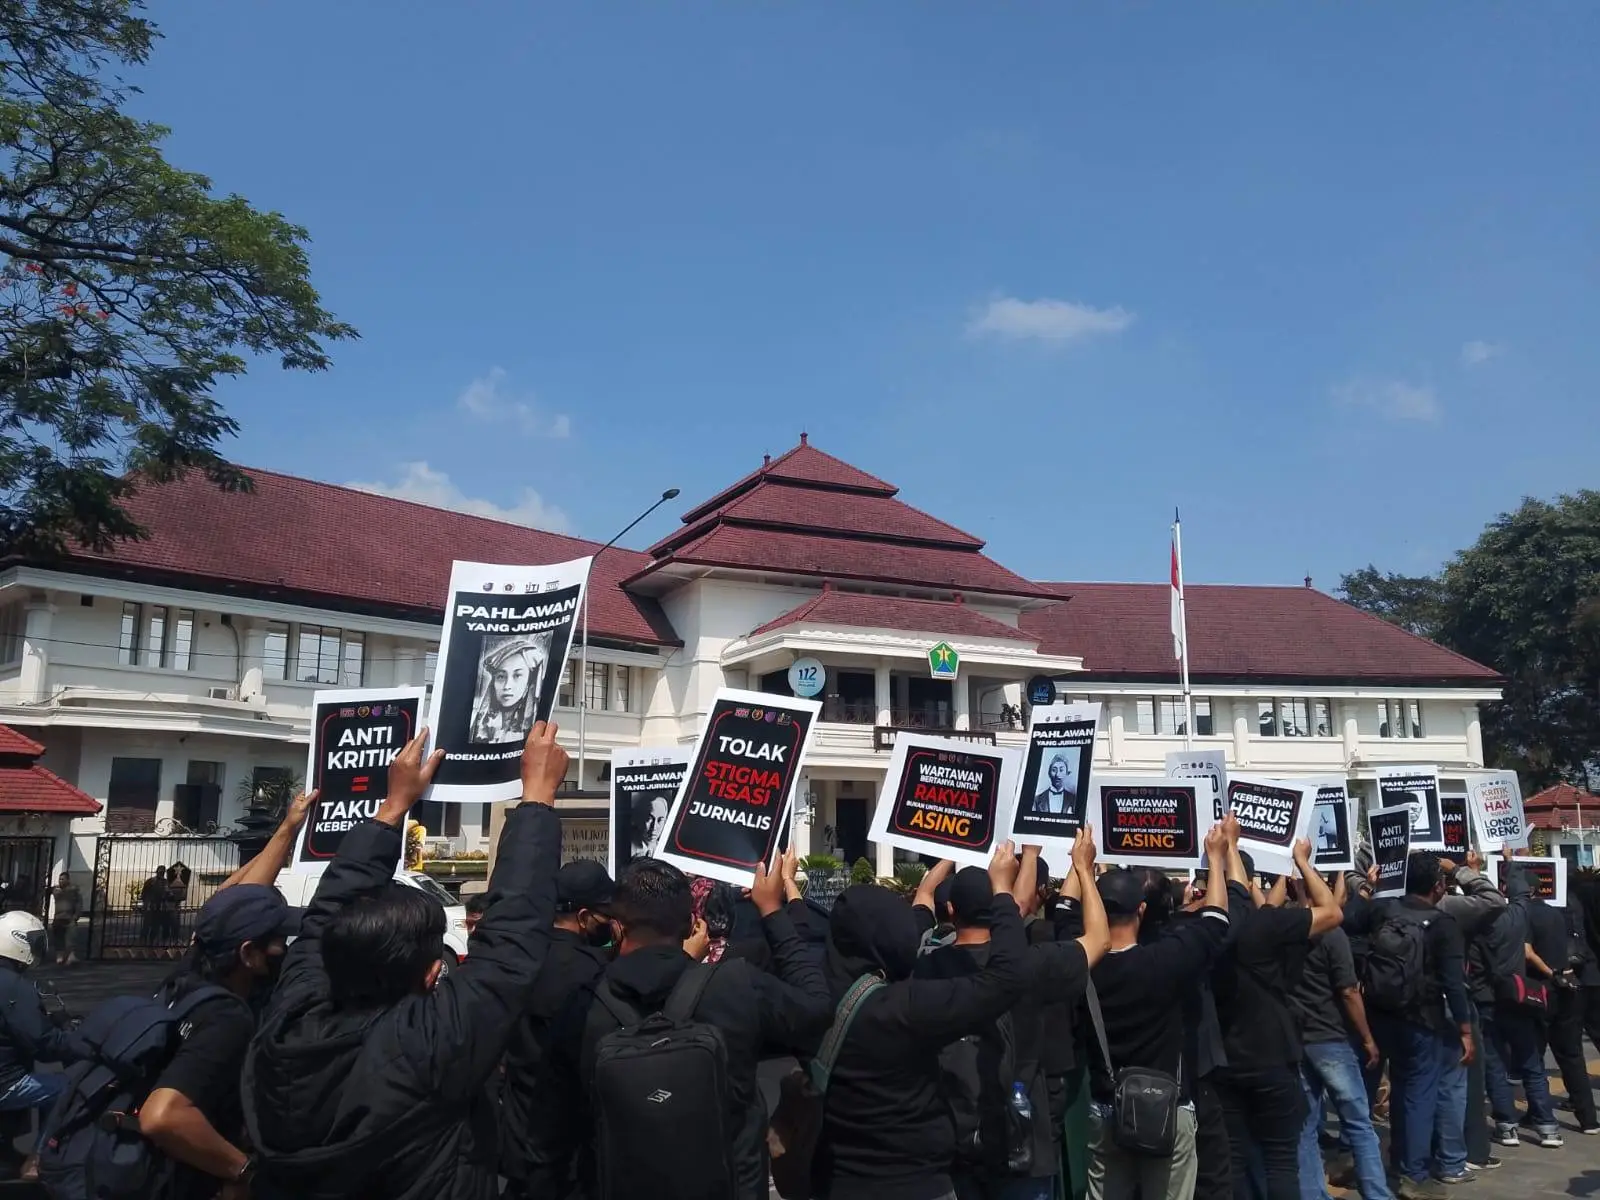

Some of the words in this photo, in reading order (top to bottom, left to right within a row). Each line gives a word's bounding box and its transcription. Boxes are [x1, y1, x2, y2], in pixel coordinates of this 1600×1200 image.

[456, 597, 577, 620] PAHLAWAN
[466, 622, 510, 632] YANG
[511, 614, 571, 633] JURNALIS
[798, 666, 818, 681] 112
[338, 726, 393, 747] ANTI
[1032, 728, 1094, 739] PAHLAWAN
[445, 753, 501, 761] ROEHANA
[501, 749, 525, 759] KOED
[718, 736, 788, 762] TOLAK
[327, 747, 402, 770] KRITIK
[616, 771, 686, 784] PAHLAWAN
[704, 760, 781, 790] STIGMA
[919, 763, 983, 784] WARTAWAN
[708, 778, 771, 806] TISASI
[919, 775, 955, 788] BERTANYA
[956, 781, 979, 791] UNTUK
[914, 784, 981, 809] RAKYAT
[1115, 798, 1178, 808] WARTAWAN
[1232, 791, 1294, 810] KEBENARAN
[1484, 799, 1512, 812] HAK
[320, 799, 387, 820] TAKU
[689, 801, 772, 831] JURNALIS
[1230, 801, 1291, 826] HARUS
[909, 810, 971, 837] ASING
[1117, 813, 1178, 828] RAKYAT
[1235, 817, 1287, 835] SUARAKAN
[1484, 816, 1519, 829] LONDO
[1381, 825, 1402, 837] ANTI
[1487, 825, 1521, 838] IRENG
[1121, 833, 1175, 848] ASING
[1378, 836, 1406, 849] KRITIK
[1380, 860, 1404, 873] TAKUT
